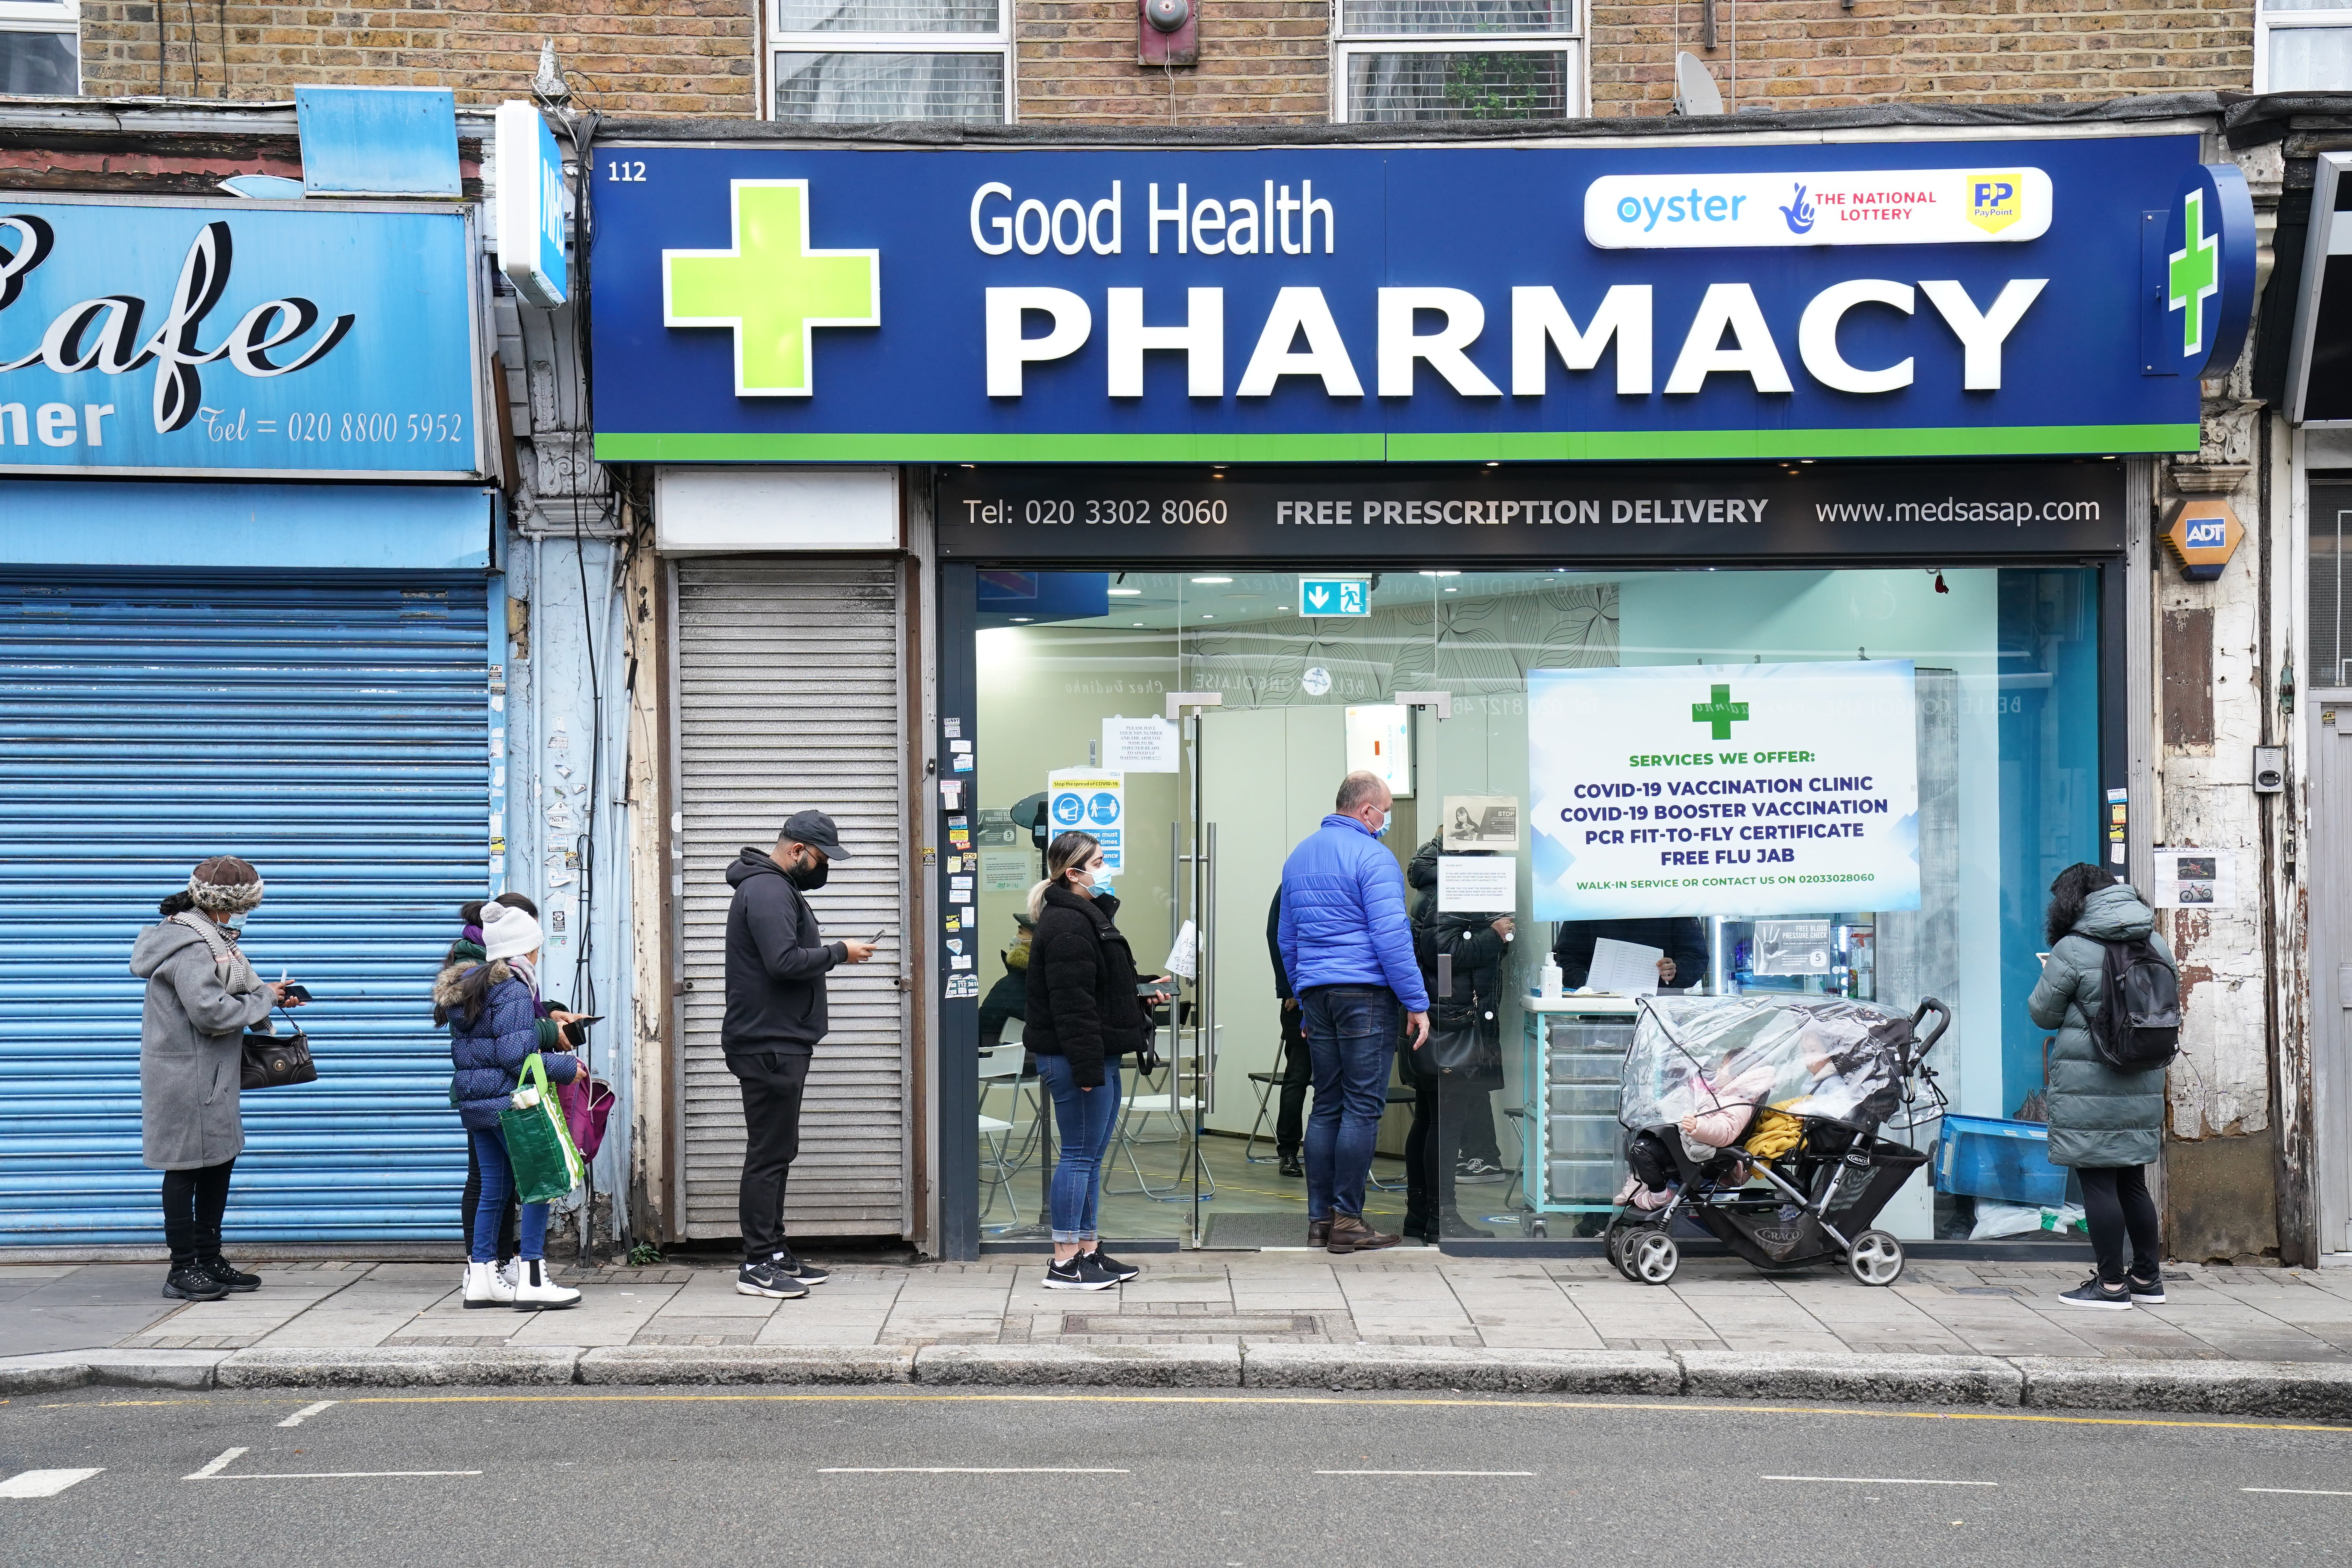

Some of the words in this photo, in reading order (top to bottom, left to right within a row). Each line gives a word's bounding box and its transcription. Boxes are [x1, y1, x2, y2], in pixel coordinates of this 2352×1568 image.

[609, 162, 646, 181] 112
[542, 157, 564, 257] NHS
[1815, 193, 1845, 205] THE
[1853, 191, 1936, 205] NATIONAL
[970, 180, 1121, 255] Good
[1149, 180, 1334, 255] Health
[1617, 188, 1746, 232] oyster
[1841, 209, 1912, 221] LOTTERY
[1975, 209, 2012, 218] PayPoint
[985, 279, 2047, 396] PHARMACY
[199, 407, 249, 441] Tel
[289, 413, 331, 441] 020
[341, 413, 397, 441] 8800
[408, 414, 461, 442] 5952
[963, 499, 1012, 524] Tel:
[1026, 500, 1074, 524] 020
[1086, 500, 1150, 524] 3302
[1162, 500, 1227, 524] 8060
[1277, 501, 1352, 524] FREE
[1364, 500, 1599, 524] PRESCRIPTION
[1612, 499, 1768, 523] DELIVERY
[1816, 497, 2100, 526] www.medsasap.com
[1630, 753, 1713, 767] SERVICES
[1719, 753, 1748, 764] WE
[1753, 751, 1815, 764] OFFER:
[1574, 782, 1661, 799] COVID-19
[1667, 778, 1802, 796] VACCINATION
[1809, 776, 1873, 792] CLINIC
[1561, 806, 1648, 822] COVID-19
[1655, 803, 1746, 819] BOOSTER
[1751, 799, 1887, 817] VACCINATION
[1586, 830, 1624, 844] PCR
[1631, 827, 1733, 843] FIT-TO-FLY
[1740, 823, 1864, 840] CERTIFICATE
[1661, 851, 1709, 866] FREE
[1715, 849, 1750, 864] FLU
[1757, 848, 1795, 863] JAB
[1577, 881, 1627, 890] WALK-IN
[1631, 879, 1679, 888] SERVICE
[1702, 877, 1756, 886] CONTACT
[1799, 874, 1874, 883] 02033028060
[1762, 1230, 1799, 1240] GRACO
